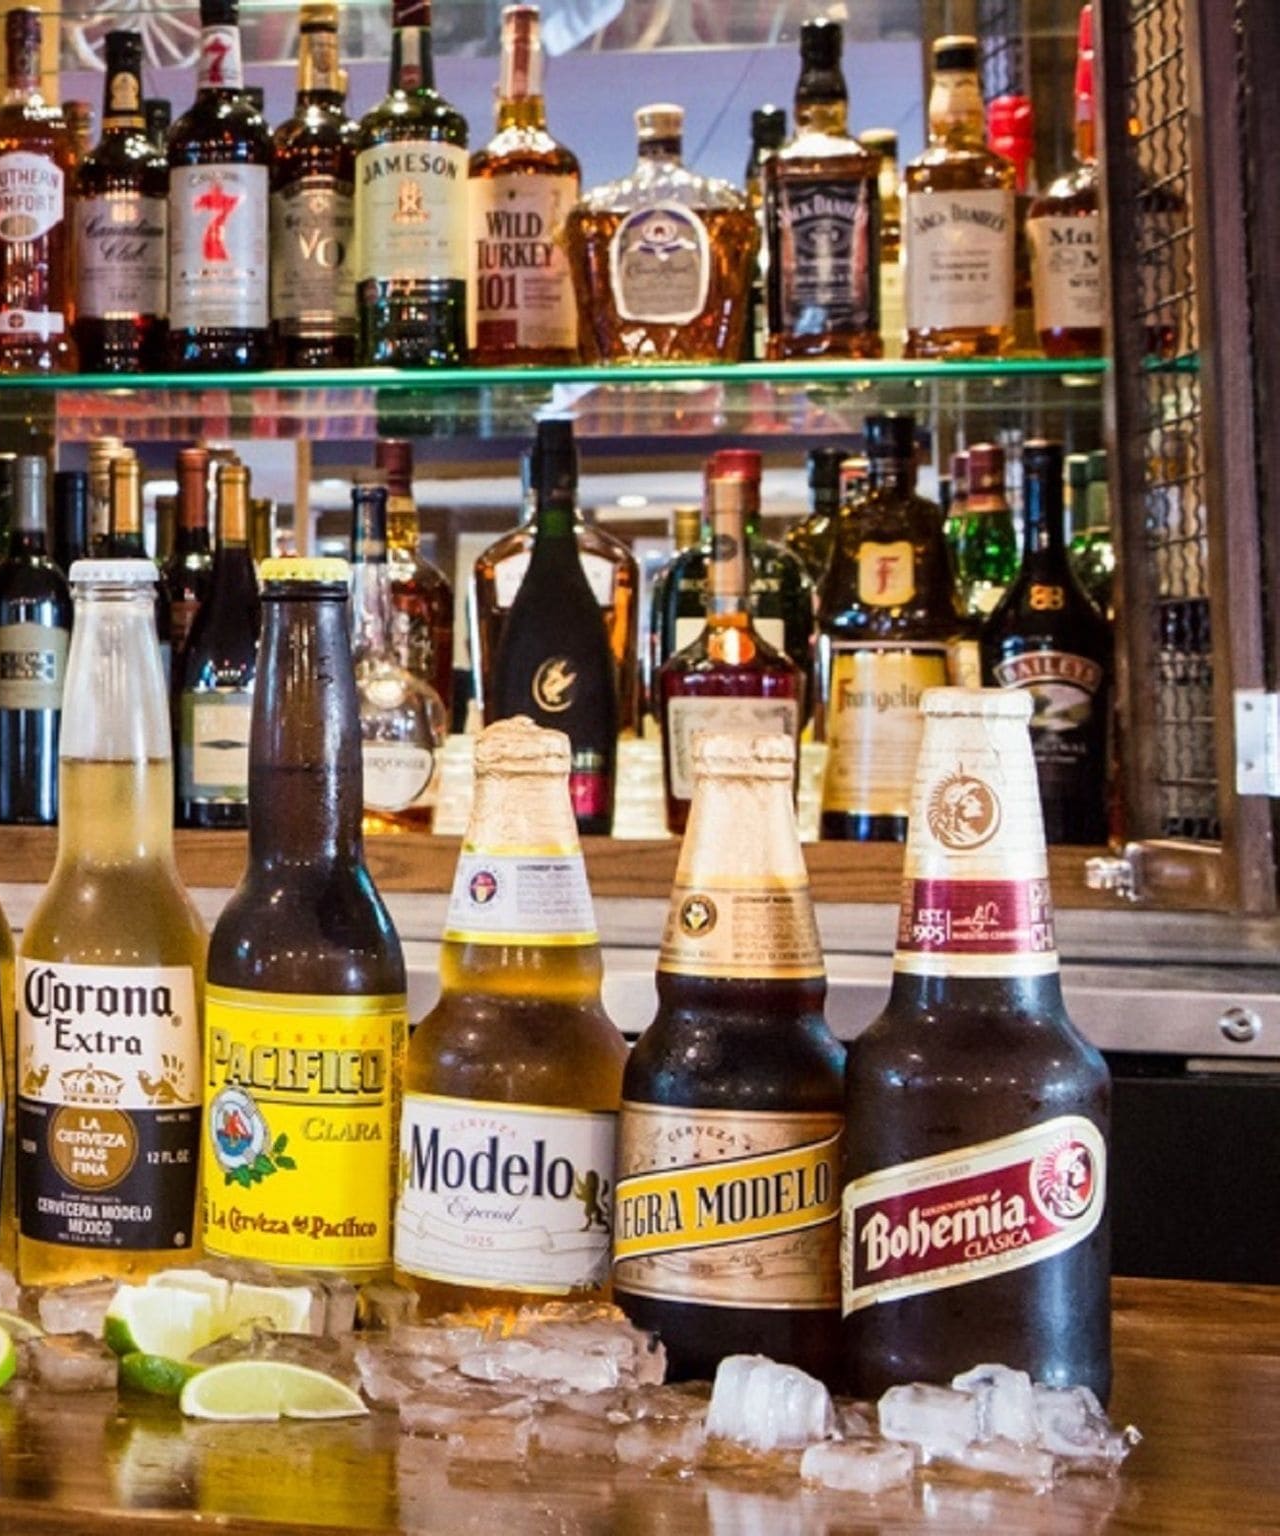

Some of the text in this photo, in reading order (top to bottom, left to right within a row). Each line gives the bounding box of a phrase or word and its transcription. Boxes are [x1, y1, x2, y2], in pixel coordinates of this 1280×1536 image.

[204, 36, 231, 84] 7
[362, 153, 459, 186] JAMESON
[192, 181, 244, 263] 7
[486, 211, 544, 239] WILD
[476, 240, 556, 270] TURKEY
[476, 273, 519, 311] 101
[1002, 658, 1096, 682] BAILEYS
[24, 965, 175, 1027] Corona
[54, 1017, 143, 1056] Extra
[250, 1030, 386, 1046] CERVEZA
[208, 1025, 386, 1095] PACIFICO
[78, 1116, 101, 1130] LA
[302, 1117, 383, 1142] CLARA
[667, 1125, 737, 1146] CERVEZA
[55, 1129, 127, 1148] CERVEZA
[71, 1161, 109, 1177] FINA
[146, 1151, 160, 1165] 12
[409, 1122, 576, 1200] Modelo
[444, 1195, 521, 1225] Especial
[696, 1161, 832, 1229] MODELO
[101, 1204, 153, 1222] MODELO
